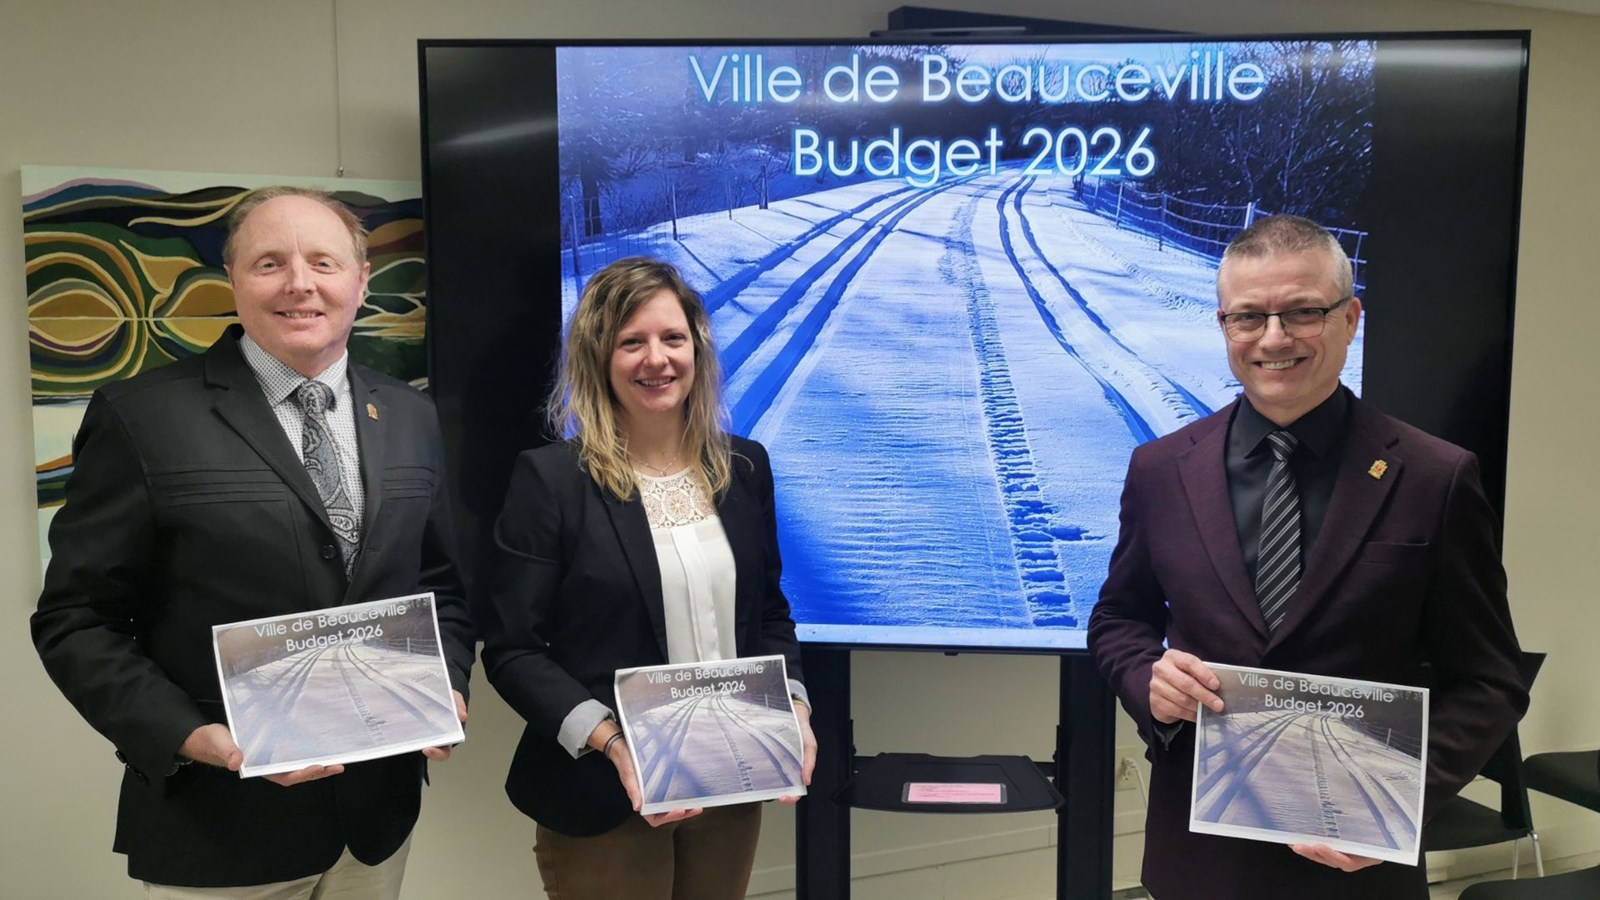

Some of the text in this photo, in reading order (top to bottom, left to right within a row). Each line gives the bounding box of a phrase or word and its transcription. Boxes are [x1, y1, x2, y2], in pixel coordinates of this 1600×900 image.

[690, 51, 1266, 103] Ville de Beauceville
[794, 126, 1156, 186] Budget 2026
[254, 603, 407, 638] Ville de Beauceville
[286, 624, 383, 652] Budget 2026
[647, 663, 764, 684] Ville de Beauceville
[1238, 673, 1394, 702] Ville de Beauceville
[670, 680, 746, 699] Budget 2026
[1264, 694, 1365, 719] Budget 2026
